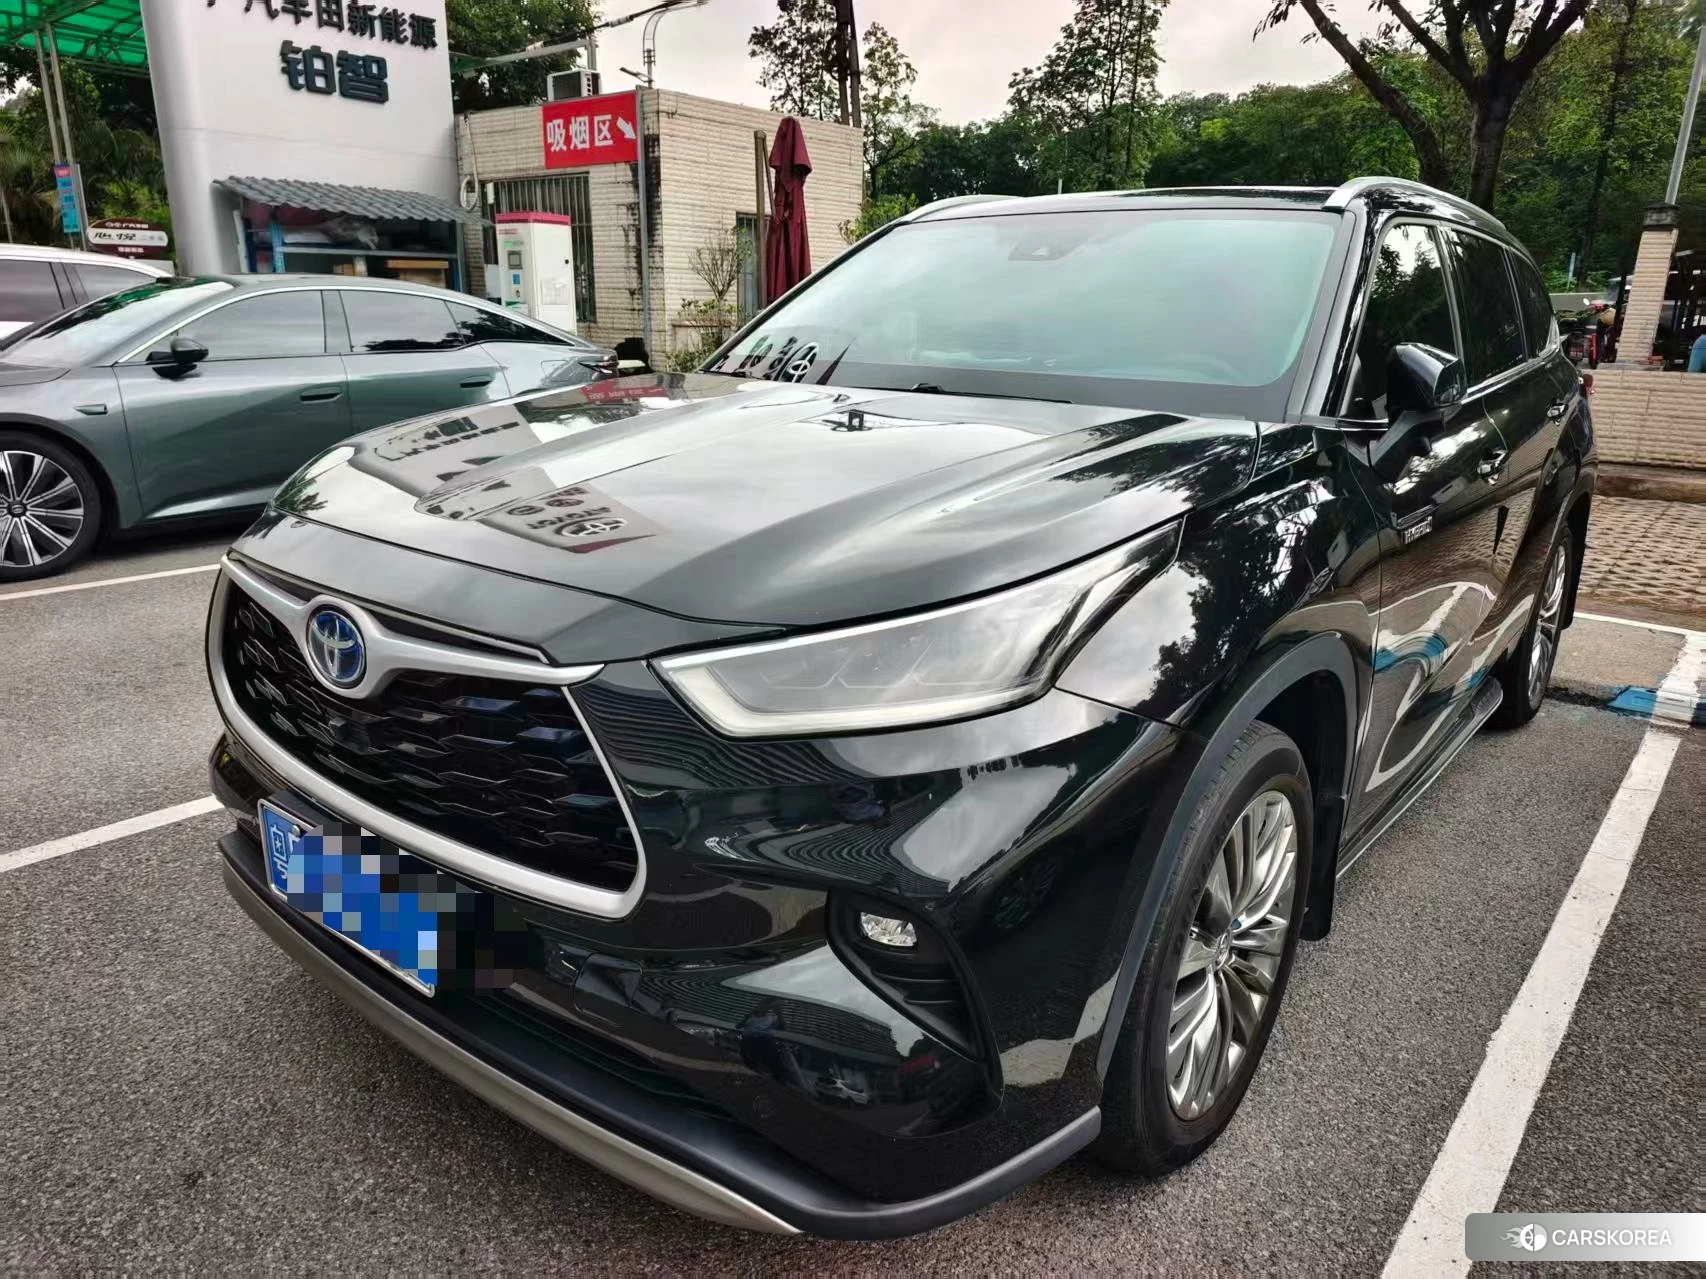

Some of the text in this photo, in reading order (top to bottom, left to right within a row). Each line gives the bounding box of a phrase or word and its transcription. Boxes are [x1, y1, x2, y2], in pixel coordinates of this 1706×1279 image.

[207, 0, 438, 50] 丰田新能源
[279, 39, 390, 105] 铂智
[546, 113, 615, 153] 吸烟区
